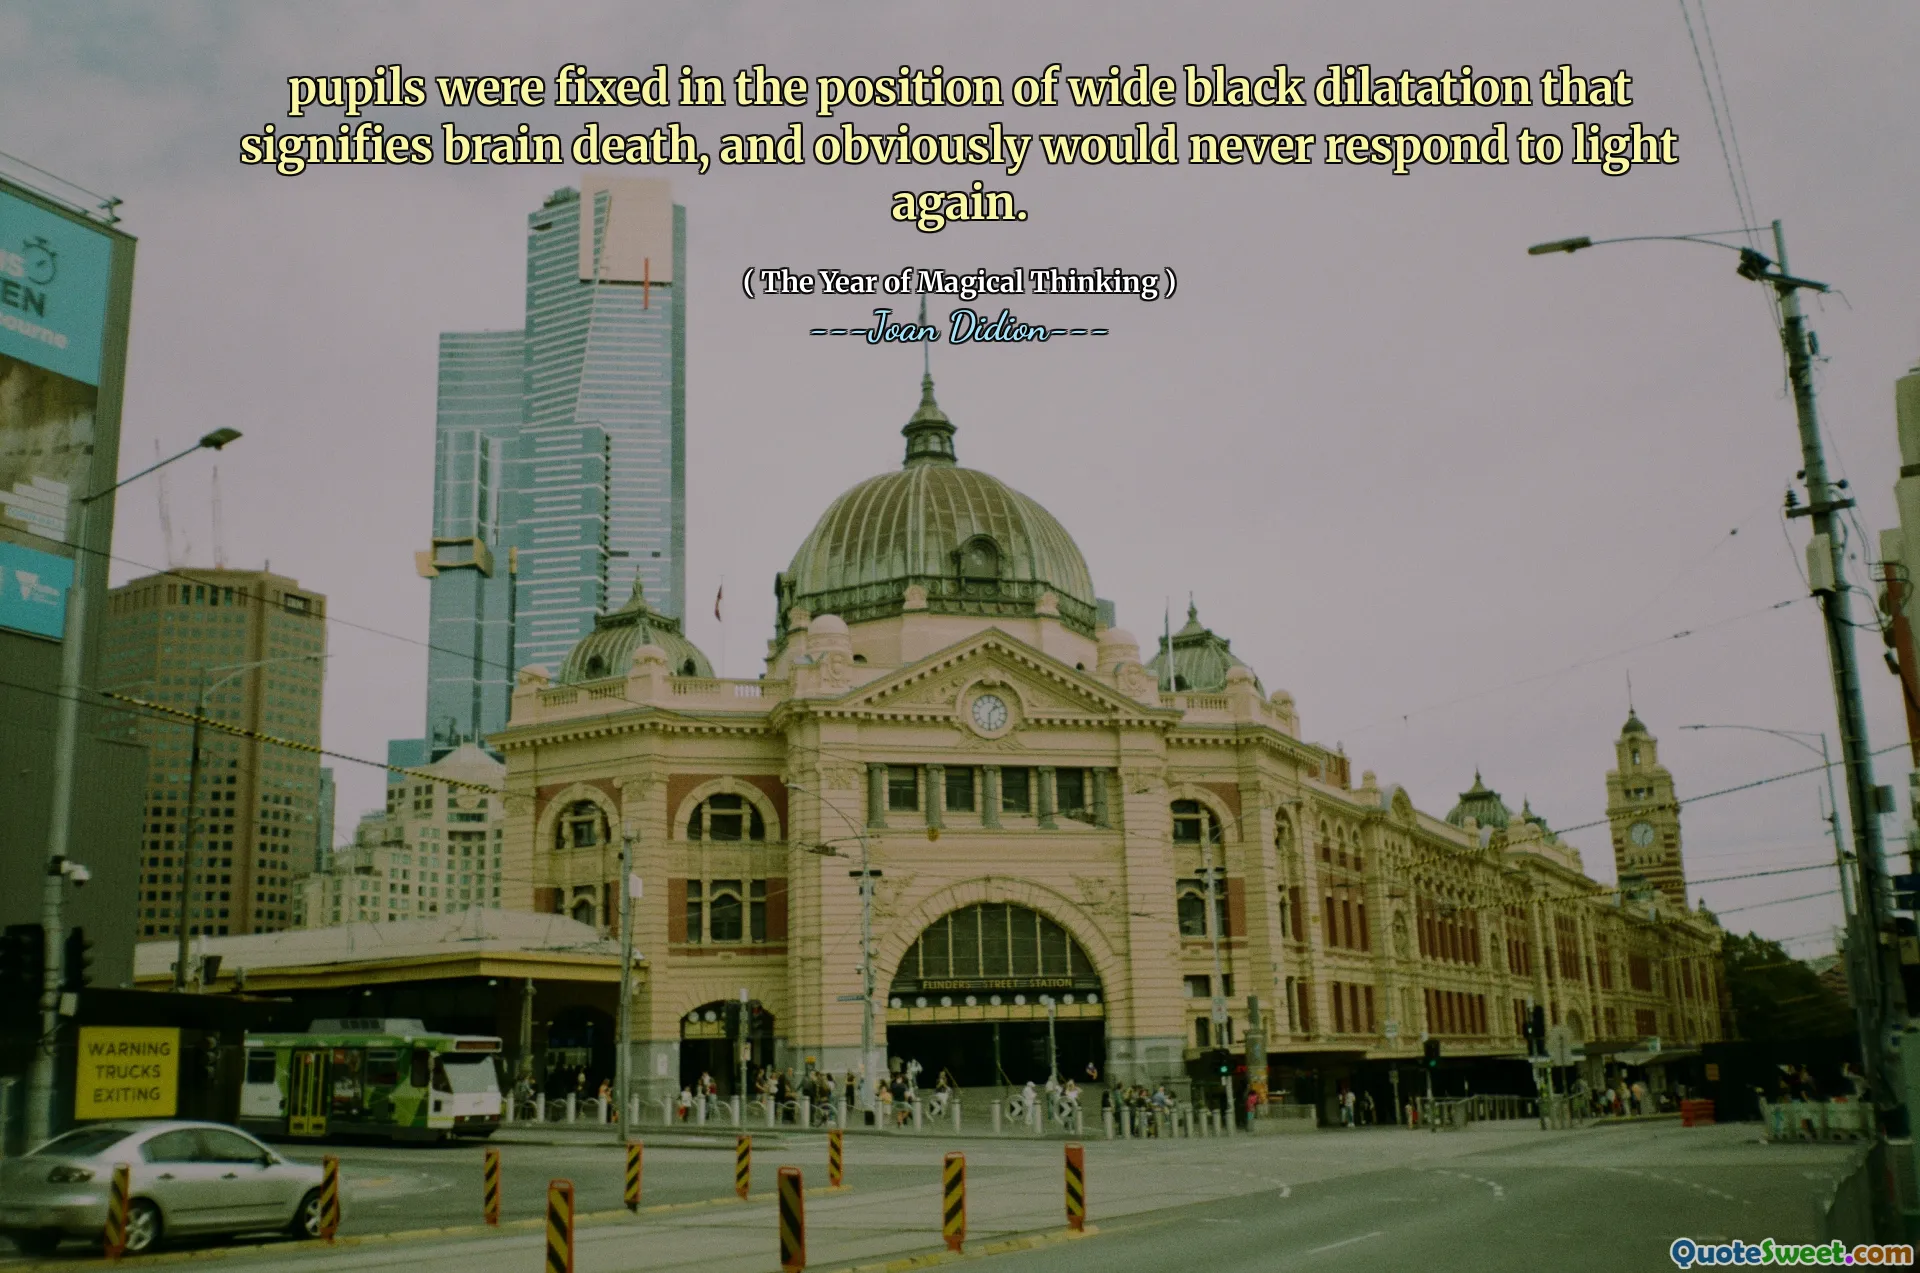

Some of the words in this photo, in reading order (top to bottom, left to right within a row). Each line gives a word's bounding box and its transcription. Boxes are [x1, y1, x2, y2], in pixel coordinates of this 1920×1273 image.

[922, 980, 971, 990] FLINDERS
[982, 979, 1018, 989] STREET
[1029, 978, 1072, 988] STATION
[88, 1042, 171, 1057] WARNING
[95, 1064, 161, 1080] TRUCKS
[93, 1087, 161, 1104] EXITING
